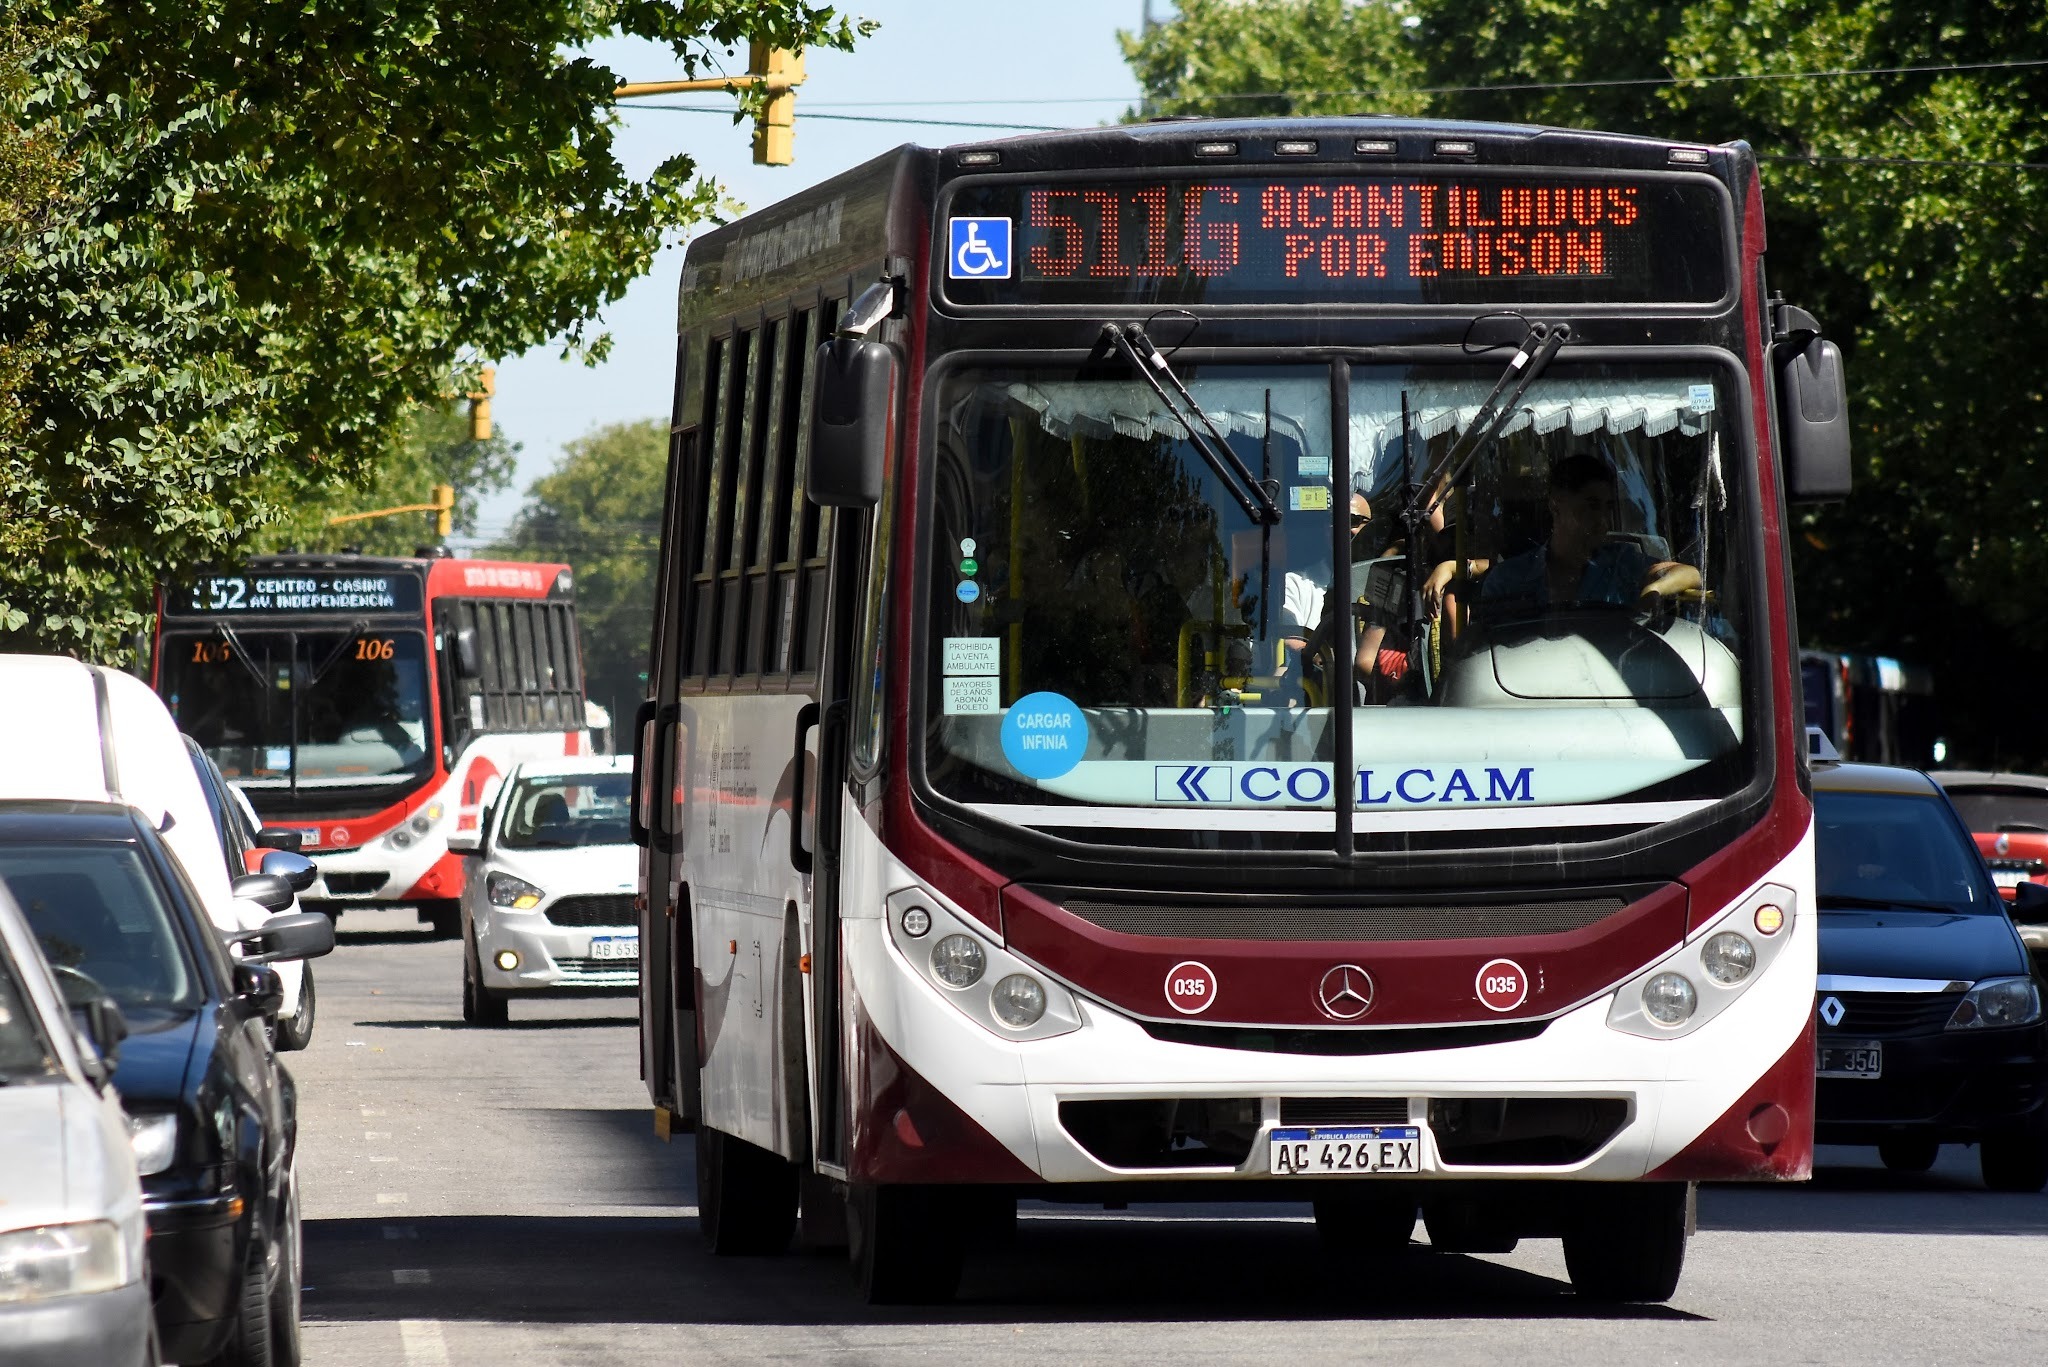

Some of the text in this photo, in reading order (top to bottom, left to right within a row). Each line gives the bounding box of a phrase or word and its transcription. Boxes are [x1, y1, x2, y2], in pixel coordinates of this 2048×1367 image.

[1285, 234, 1387, 277] POR
[256, 578, 317, 593] CENTRO
[332, 578, 387, 593] CASINO
[276, 593, 395, 608] INDEPENDENCIA
[355, 639, 395, 660] 106
[949, 643, 993, 651] PROHIBIDA
[969, 688, 993, 696] AÑOS
[1017, 713, 1071, 729] CARGAR
[1022, 734, 1068, 750] INFINIA
[1240, 767, 1535, 804] COLCAM
[1174, 978, 1205, 996] 035
[1485, 976, 1517, 994] 035
[1844, 1050, 1879, 1071] 354
[1277, 1142, 1413, 1170] AC 426 EX
